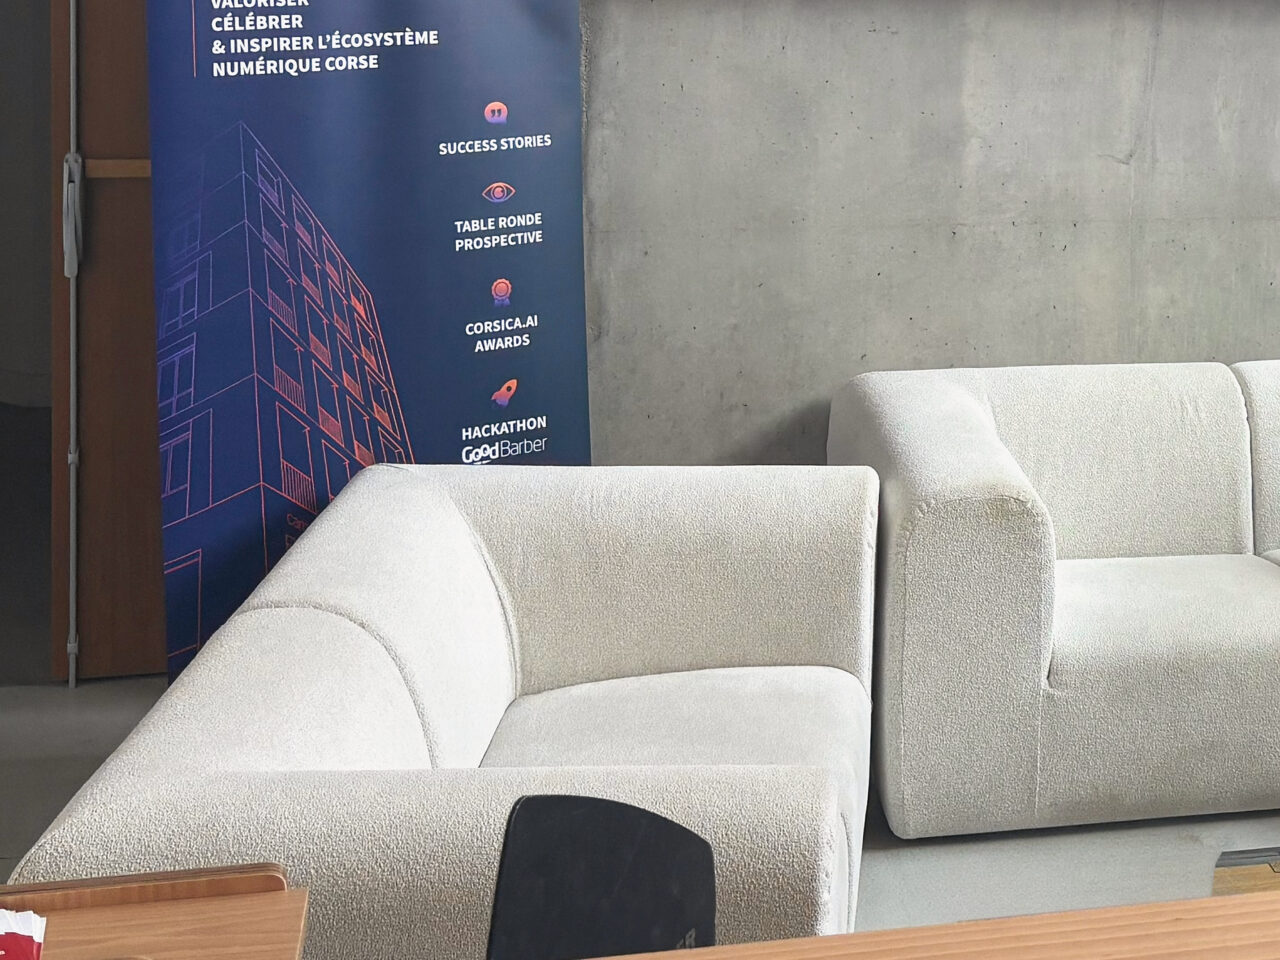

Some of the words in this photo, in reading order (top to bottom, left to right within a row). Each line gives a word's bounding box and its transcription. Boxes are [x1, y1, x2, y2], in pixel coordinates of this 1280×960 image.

[211, 12, 304, 32] CÉLÉBRER
[212, 39, 226, 55] &
[230, 36, 314, 54] INSPIRER
[212, 56, 321, 77] NUMÉRIQUE
[325, 55, 379, 71] CORSE
[438, 139, 498, 156] SUCCESS
[500, 134, 552, 150] STORIES
[454, 218, 496, 234] TABLE
[499, 213, 543, 229] RONDE
[455, 230, 543, 252] PROSPECTIVE
[465, 314, 538, 336] CORSICA.AI
[474, 334, 531, 353] AWARDS
[461, 416, 547, 441] HACKATHON
